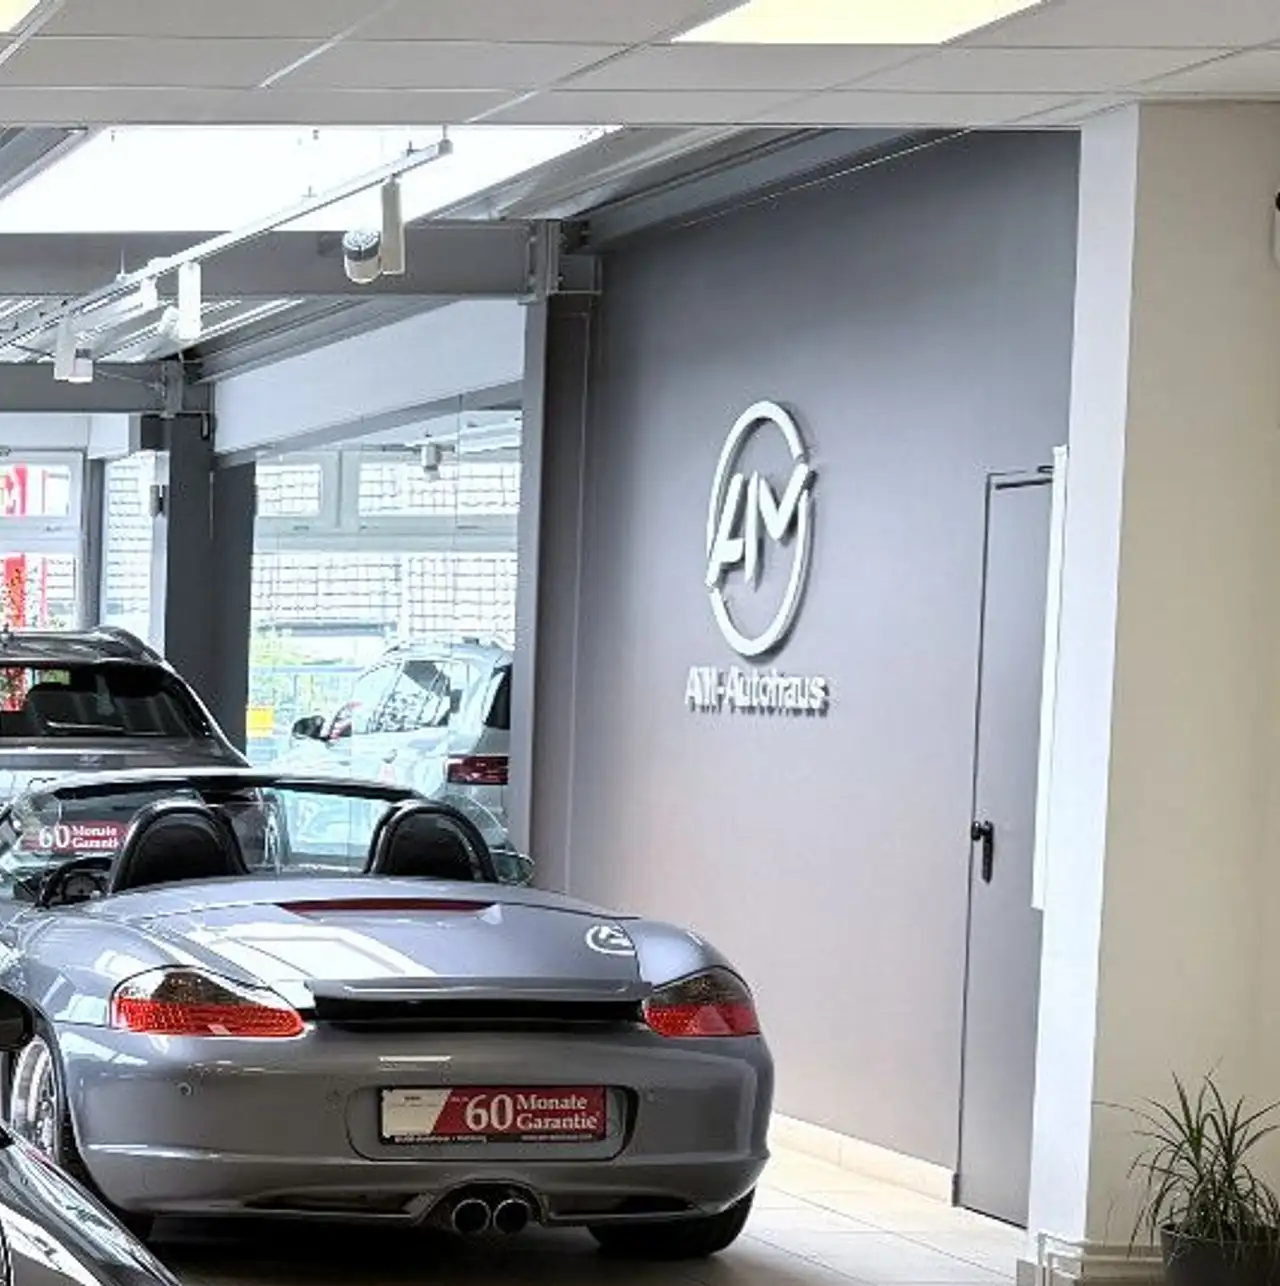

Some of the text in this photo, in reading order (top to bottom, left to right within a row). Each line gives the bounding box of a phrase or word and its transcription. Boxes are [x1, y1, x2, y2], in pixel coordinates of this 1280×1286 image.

[38, 823, 71, 848] 60
[71, 836, 121, 849] Garanti
[465, 1093, 589, 1132] 60 Monate
